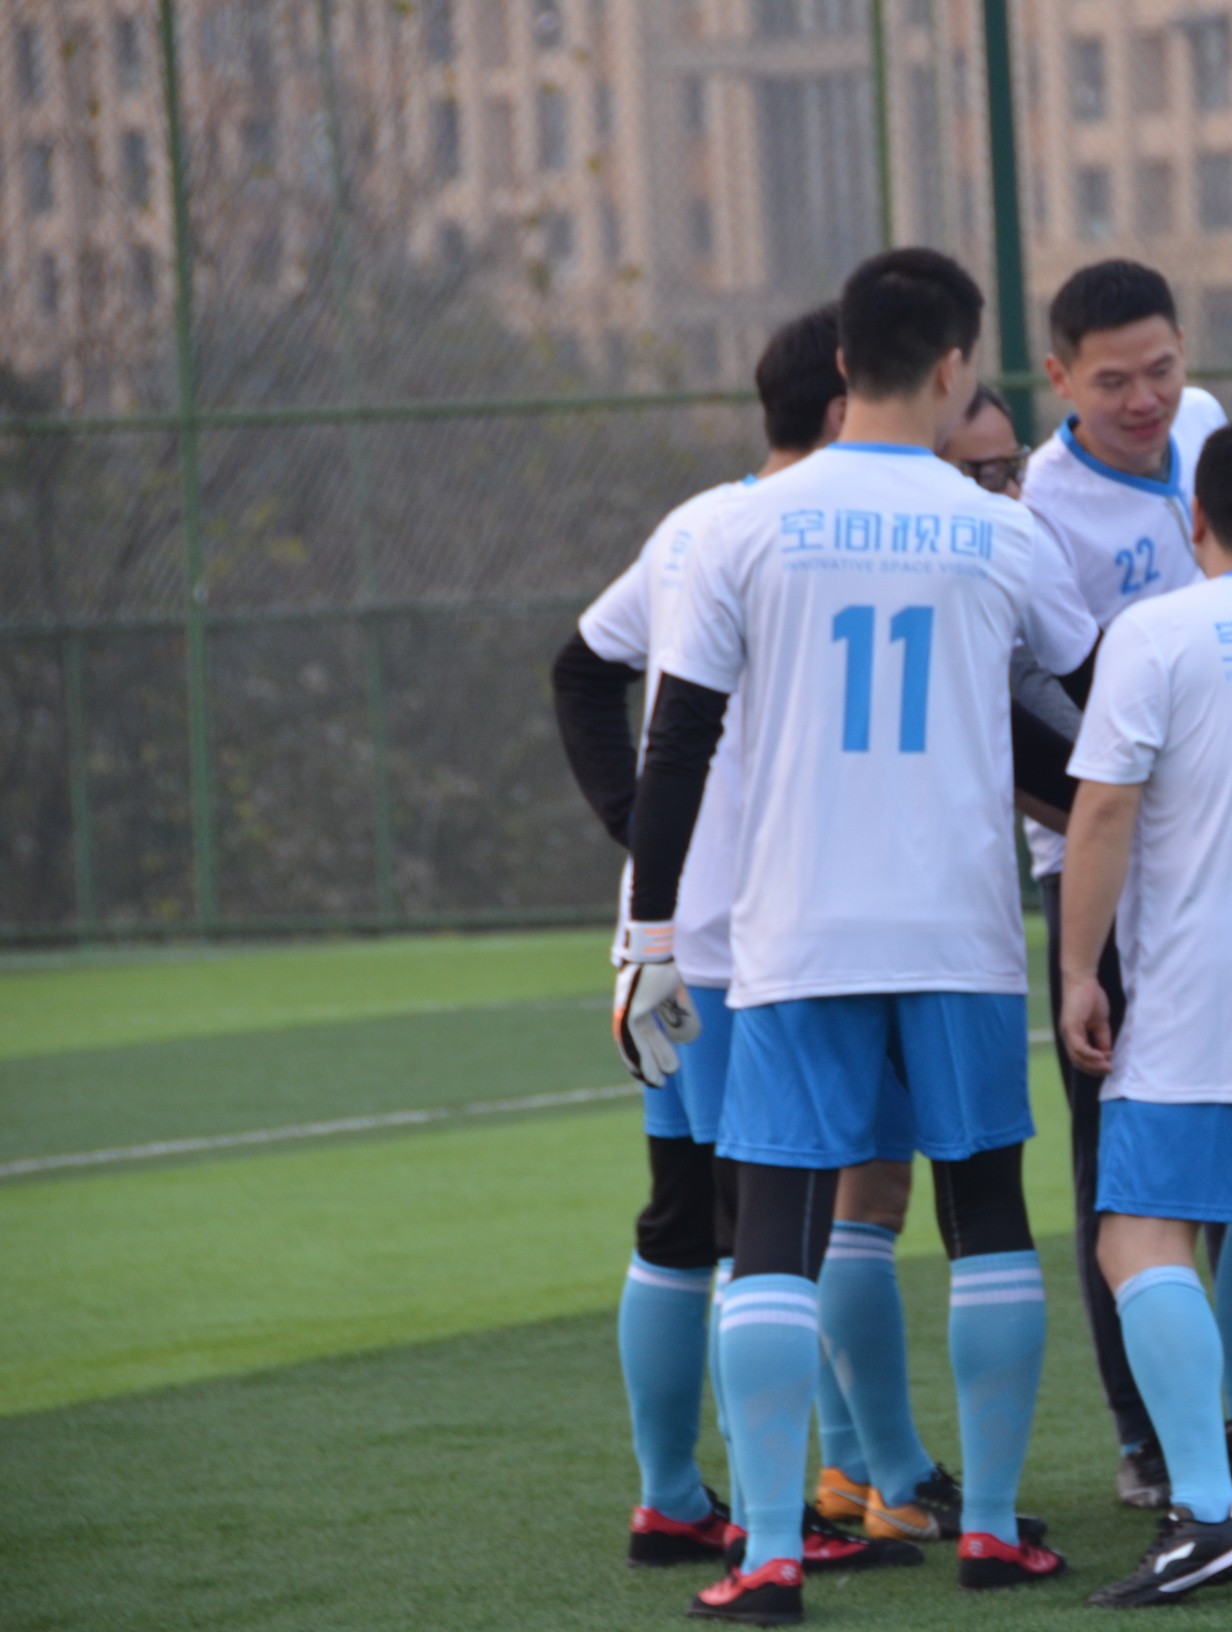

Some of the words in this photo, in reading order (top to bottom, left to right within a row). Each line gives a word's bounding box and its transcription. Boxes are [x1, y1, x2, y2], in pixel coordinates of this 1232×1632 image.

[784, 558, 873, 573] INNOVATIVE
[880, 559, 932, 573] SPACE
[1114, 537, 1160, 595] 22
[832, 605, 934, 752] 11
